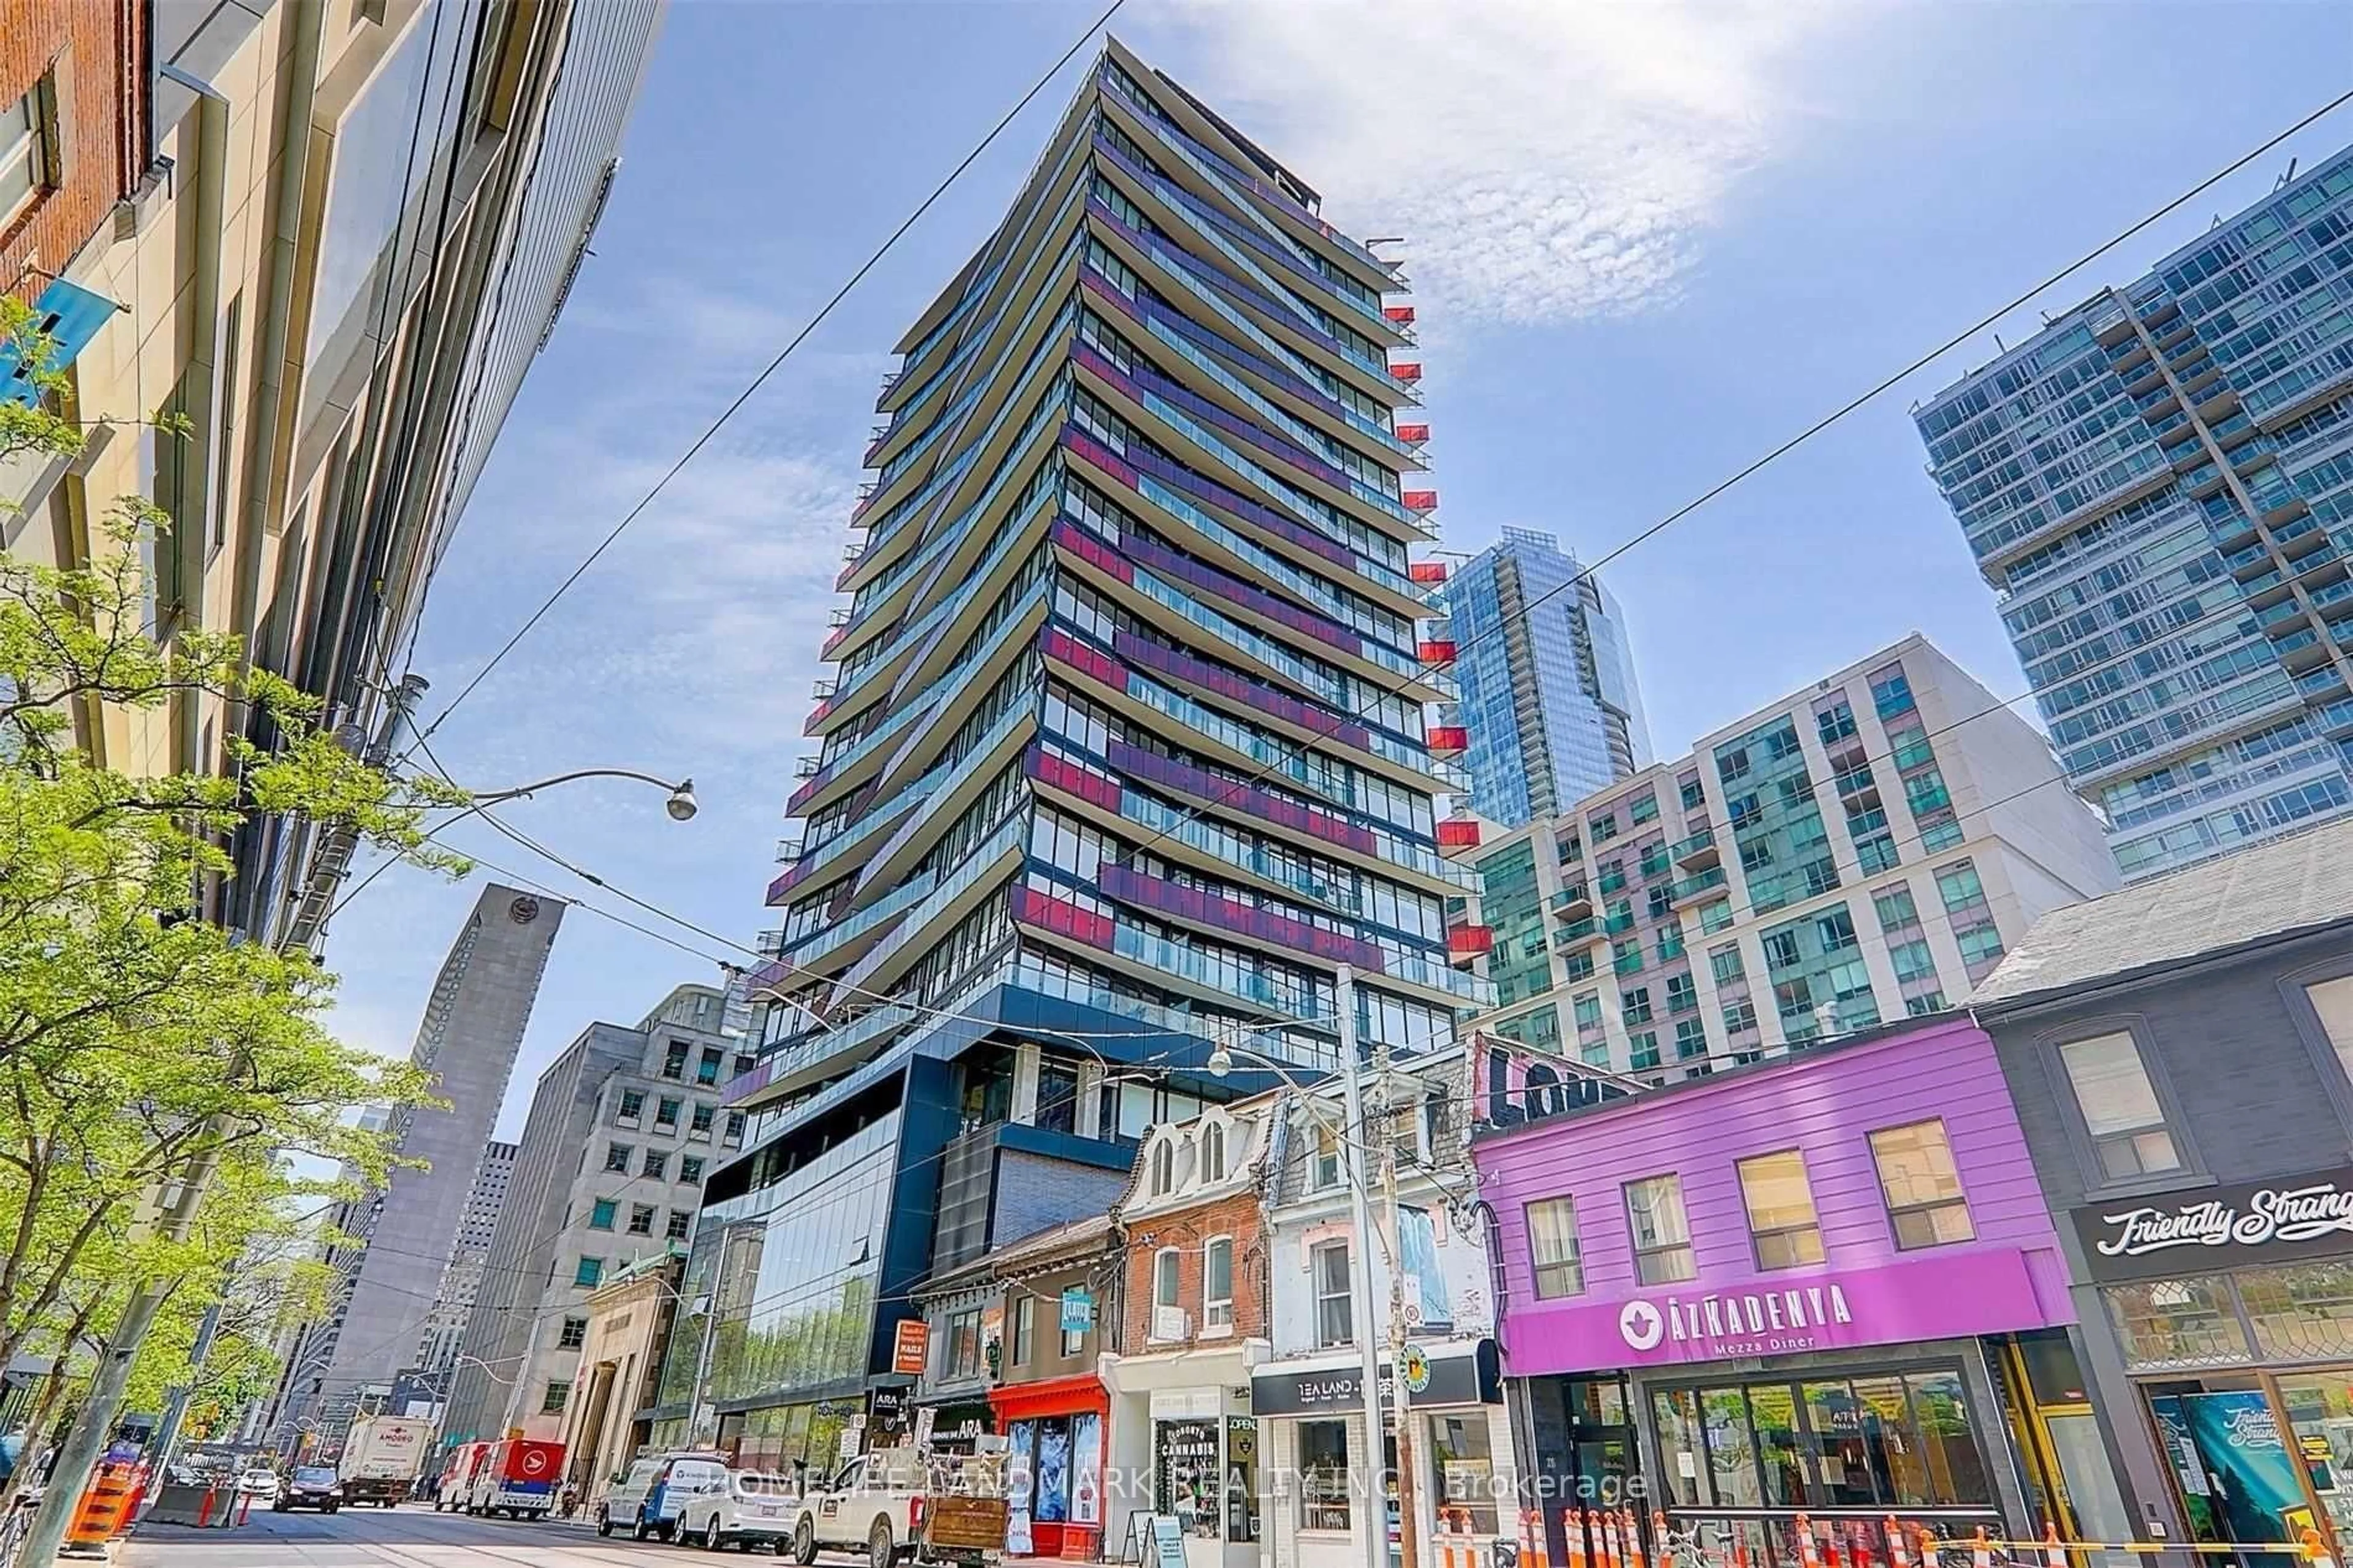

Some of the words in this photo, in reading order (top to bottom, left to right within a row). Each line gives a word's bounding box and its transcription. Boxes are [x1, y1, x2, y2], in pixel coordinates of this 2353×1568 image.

[2097, 1202, 2235, 1256] Friendly
[1715, 1342, 1763, 1355] Mezza
[1770, 1336, 1815, 1349] Diner
[1298, 1384, 1320, 1396] TEA
[1322, 1379, 1352, 1394] LAND
[876, 1394, 898, 1404] ARA
[958, 1418, 982, 1439] ARA
[1162, 1442, 1214, 1456] CANNABIS
